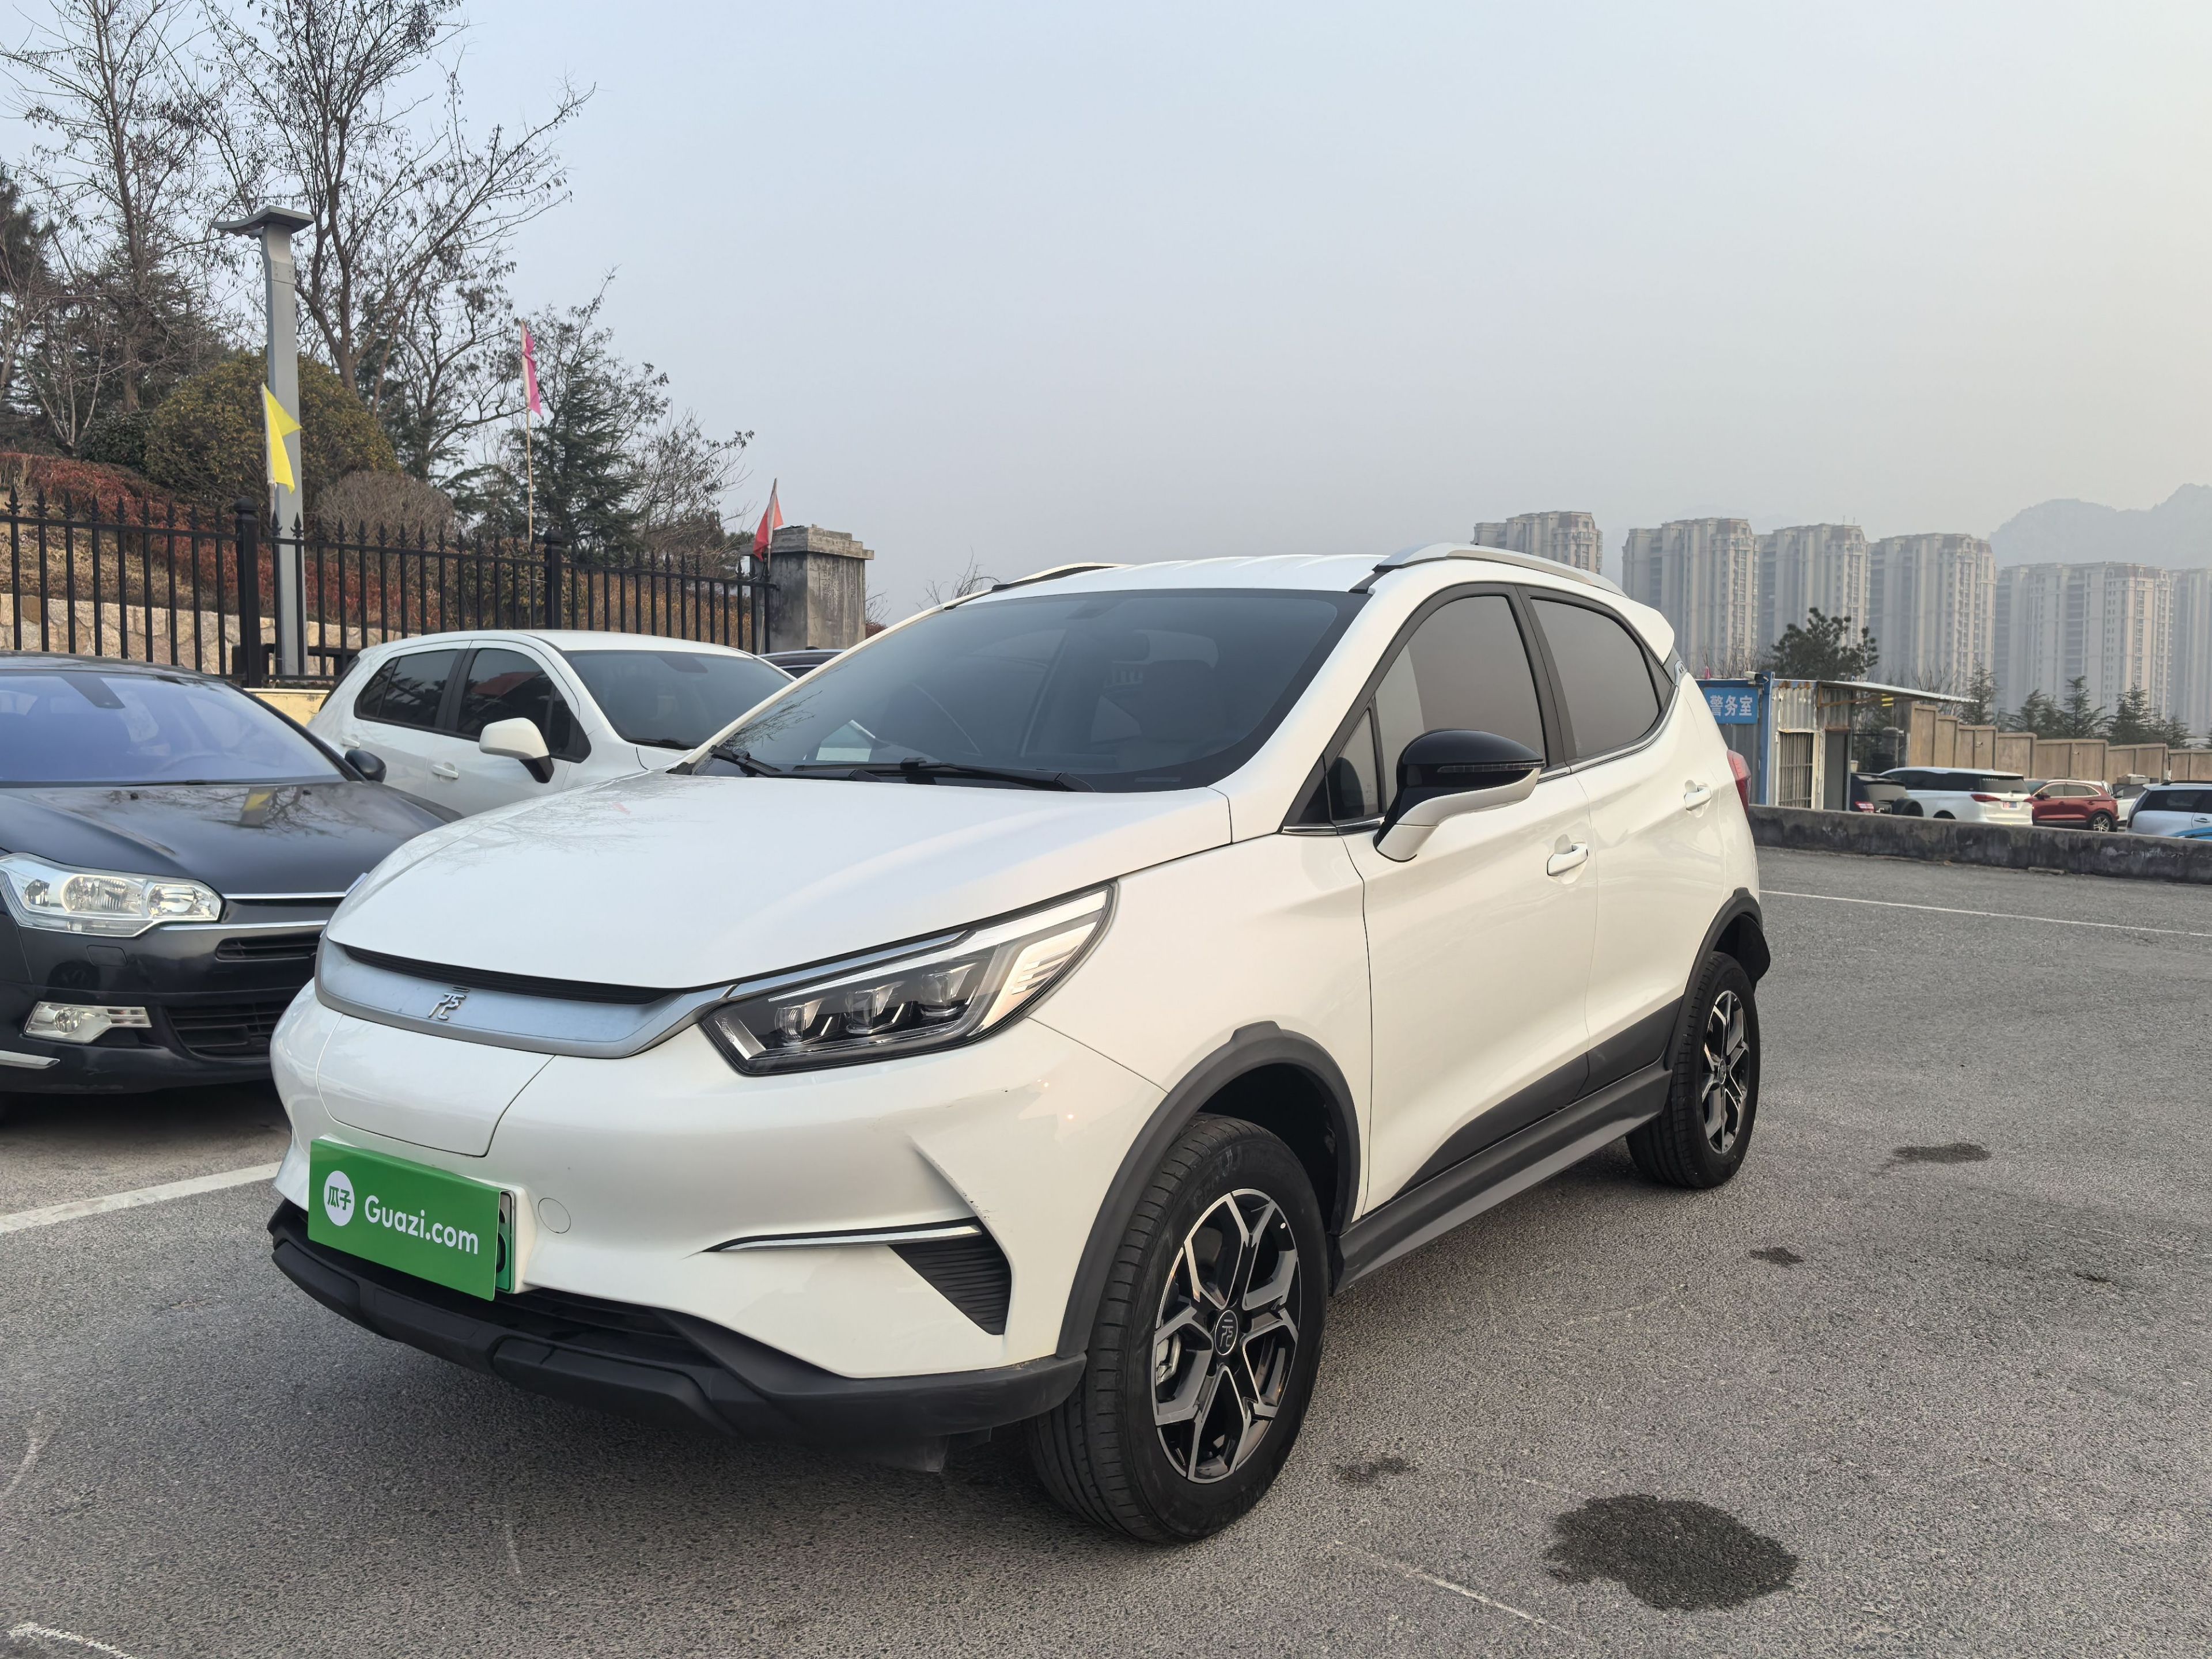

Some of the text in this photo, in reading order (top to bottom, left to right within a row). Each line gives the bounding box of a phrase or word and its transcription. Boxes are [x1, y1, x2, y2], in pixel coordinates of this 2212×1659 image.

[1710, 695, 1753, 717] 警务室
[327, 1185, 351, 1210] 瓜子
[365, 1195, 478, 1255] Guazi.com
